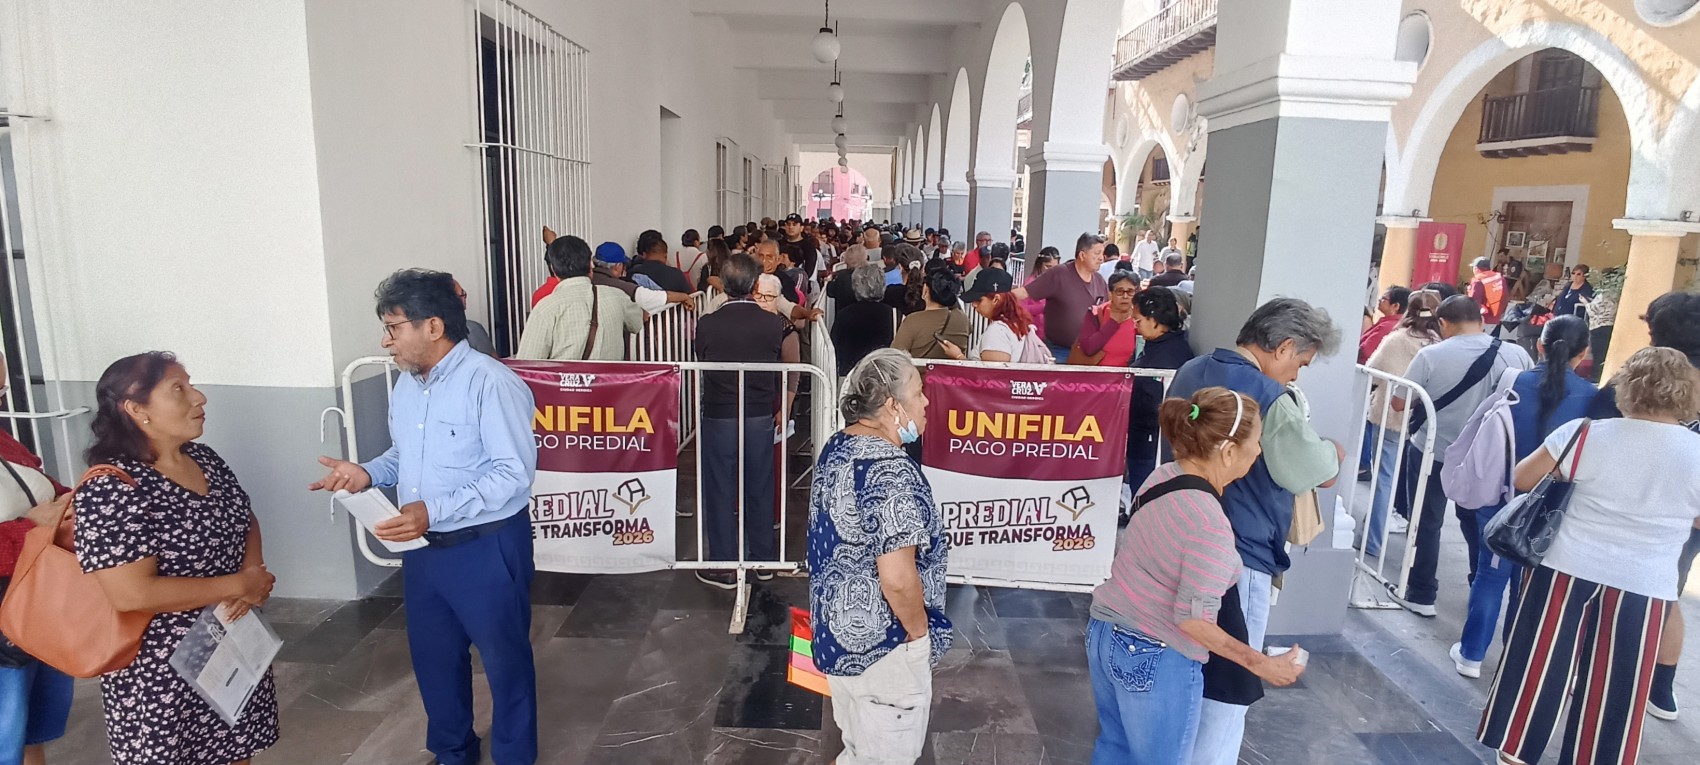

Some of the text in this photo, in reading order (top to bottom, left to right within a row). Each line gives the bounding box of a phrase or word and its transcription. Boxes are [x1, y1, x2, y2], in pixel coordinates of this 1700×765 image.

[1010, 380, 1032, 389] VERA
[532, 405, 655, 434] NIFILA
[948, 409, 1104, 442] UNIFILA
[565, 435, 651, 452] PREDIAL
[950, 438, 1099, 460] PAGO PREDIAL
[529, 489, 615, 523] EDIAL
[941, 497, 1057, 529] PREDIAL
[540, 517, 651, 539] TRANSFORMA
[613, 530, 654, 546] 2026
[978, 523, 1093, 545] TRANSFORMA
[1052, 535, 1095, 551] 2026
